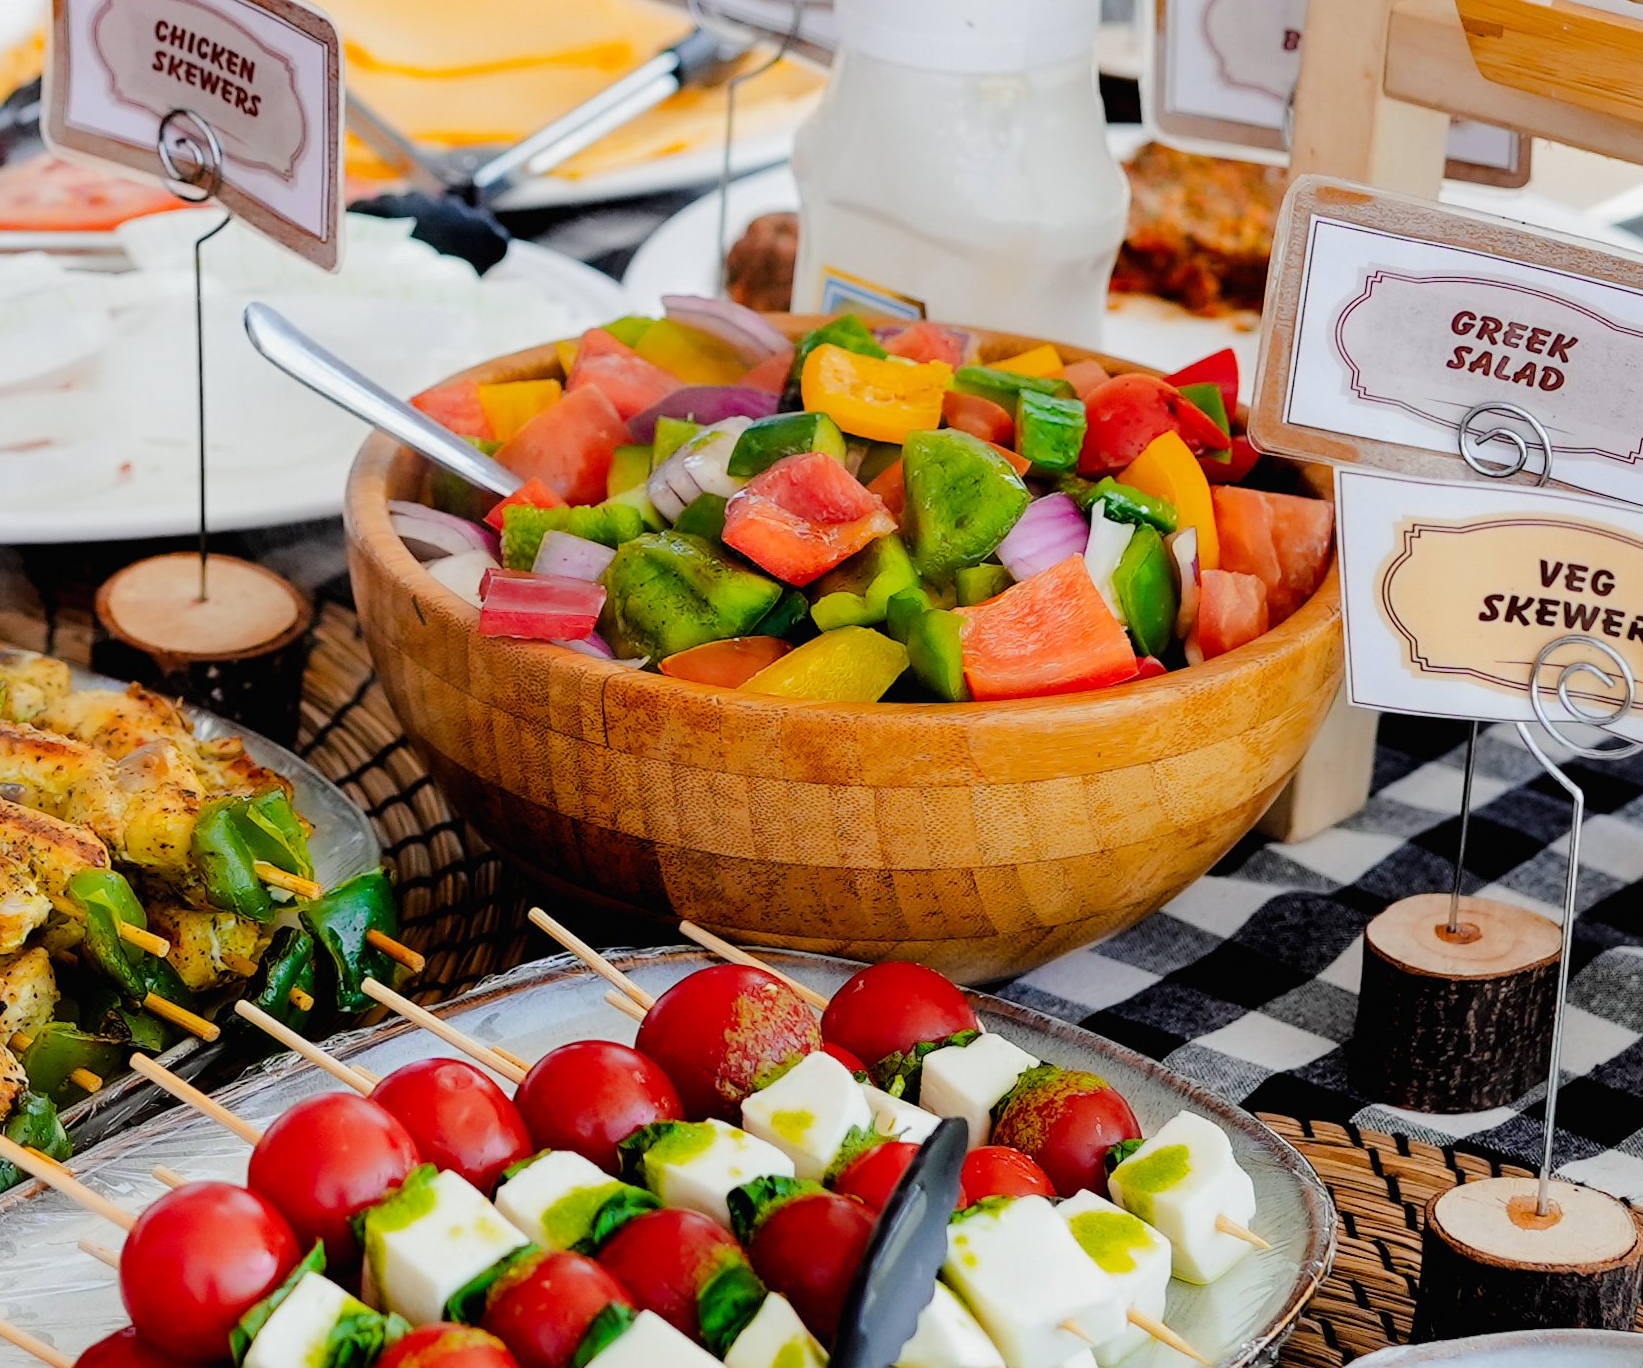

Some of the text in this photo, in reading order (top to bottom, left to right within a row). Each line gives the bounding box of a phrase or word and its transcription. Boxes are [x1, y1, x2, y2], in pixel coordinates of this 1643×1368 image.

[155, 20, 255, 84] CHICKEN
[153, 50, 261, 117] SKEWERS
[1451, 310, 1578, 363] GREEK
[1446, 345, 1564, 391] SALAD
[1540, 559, 1615, 596] VEG
